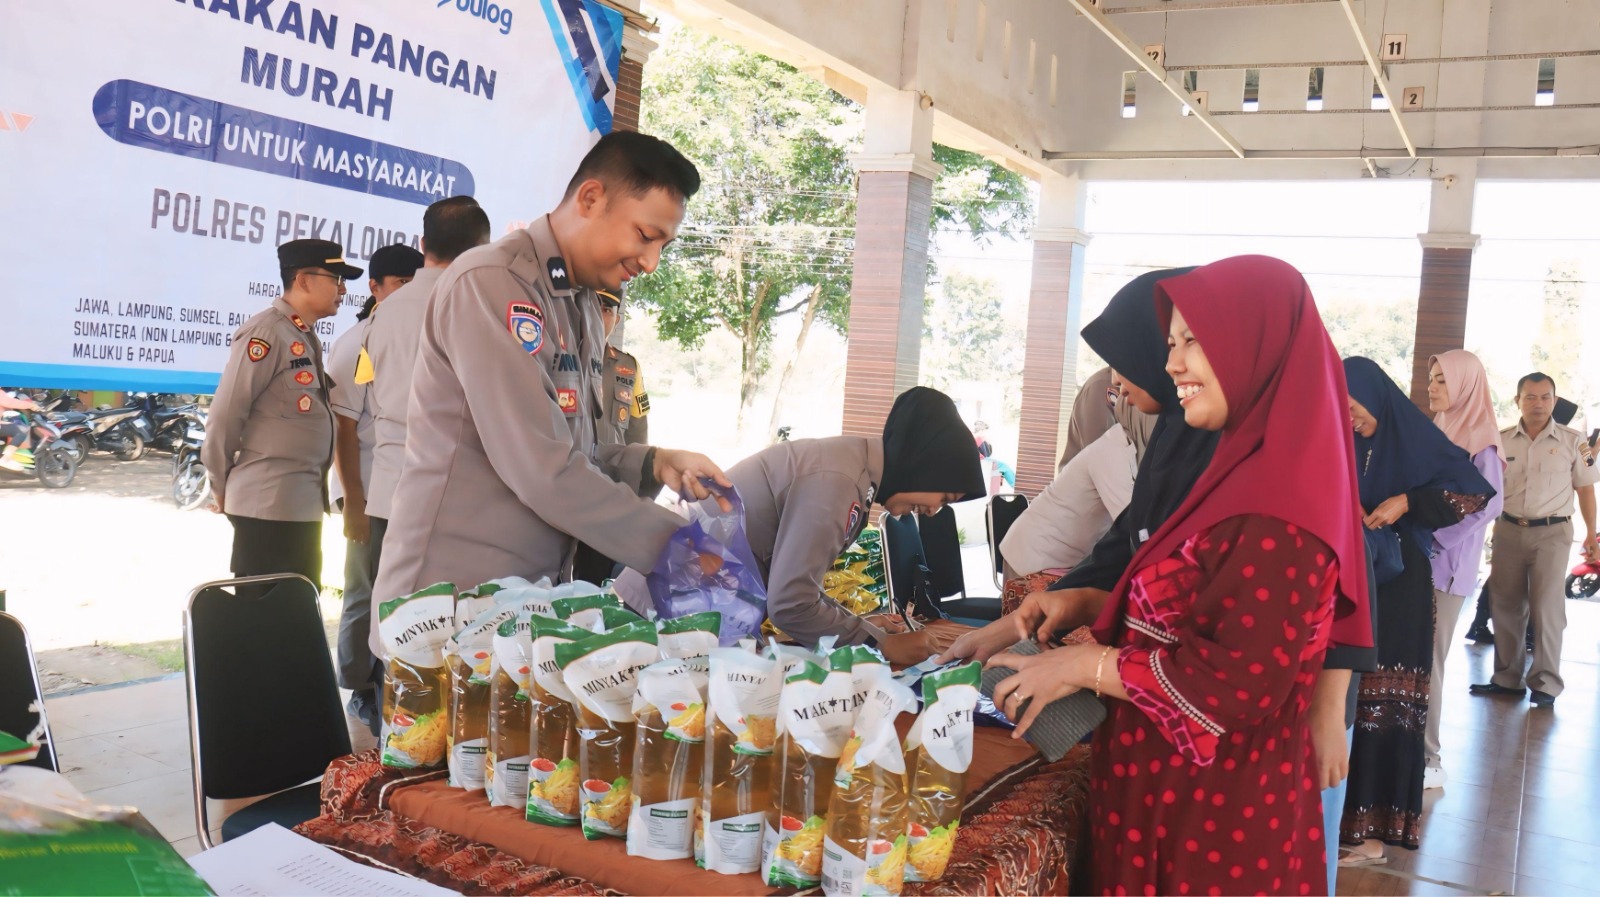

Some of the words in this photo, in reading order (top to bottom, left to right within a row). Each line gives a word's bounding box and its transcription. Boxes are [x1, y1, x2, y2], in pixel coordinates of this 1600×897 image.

[351, 22, 497, 101] PANGAN
[1388, 41, 1402, 55] 11
[241, 46, 394, 122] MURAH
[1409, 93, 1418, 105] 2
[128, 100, 213, 146] POLRI
[223, 122, 307, 167] UNTUK
[312, 145, 456, 198] MASYARAKAT
[151, 188, 266, 244] POLRES
[248, 281, 281, 298] HARGA
[75, 297, 113, 315] JAWA,
[118, 301, 175, 322] LAMPUNG,
[179, 307, 224, 327] SUMSEL,
[74, 321, 136, 341] SUMATERA
[141, 325, 168, 344] (NON
[172, 327, 222, 347] LAMPUNG
[73, 342, 122, 361] MALUKU
[127, 346, 134, 361] &
[139, 346, 175, 364] PAPUA
